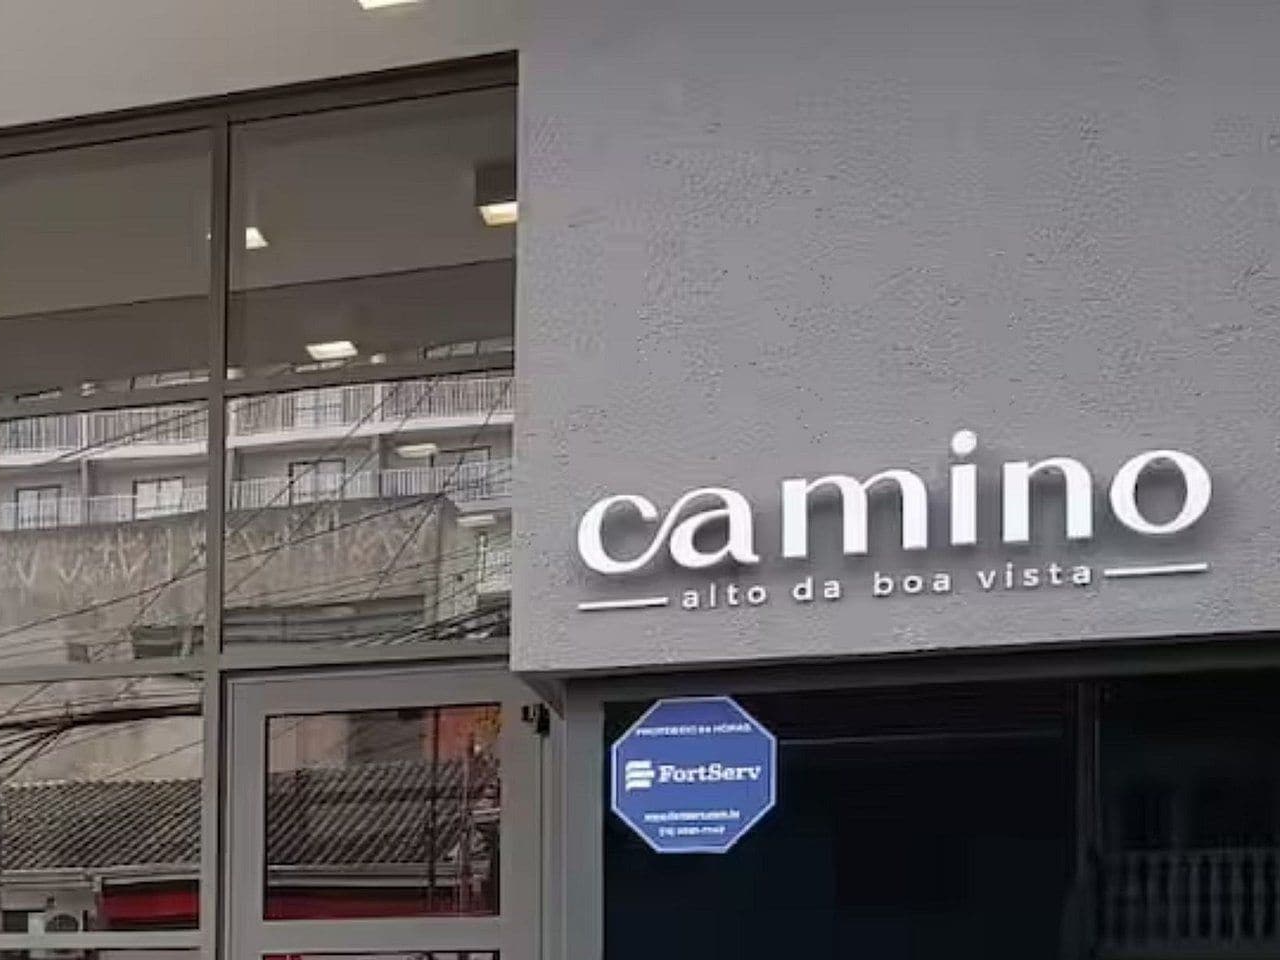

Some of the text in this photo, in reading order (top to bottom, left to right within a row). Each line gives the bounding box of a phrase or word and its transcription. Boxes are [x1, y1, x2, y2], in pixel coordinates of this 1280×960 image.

[577, 429, 1212, 575] camino
[681, 561, 1092, 609] alto da boa vista
[658, 762, 762, 784] FortServ
